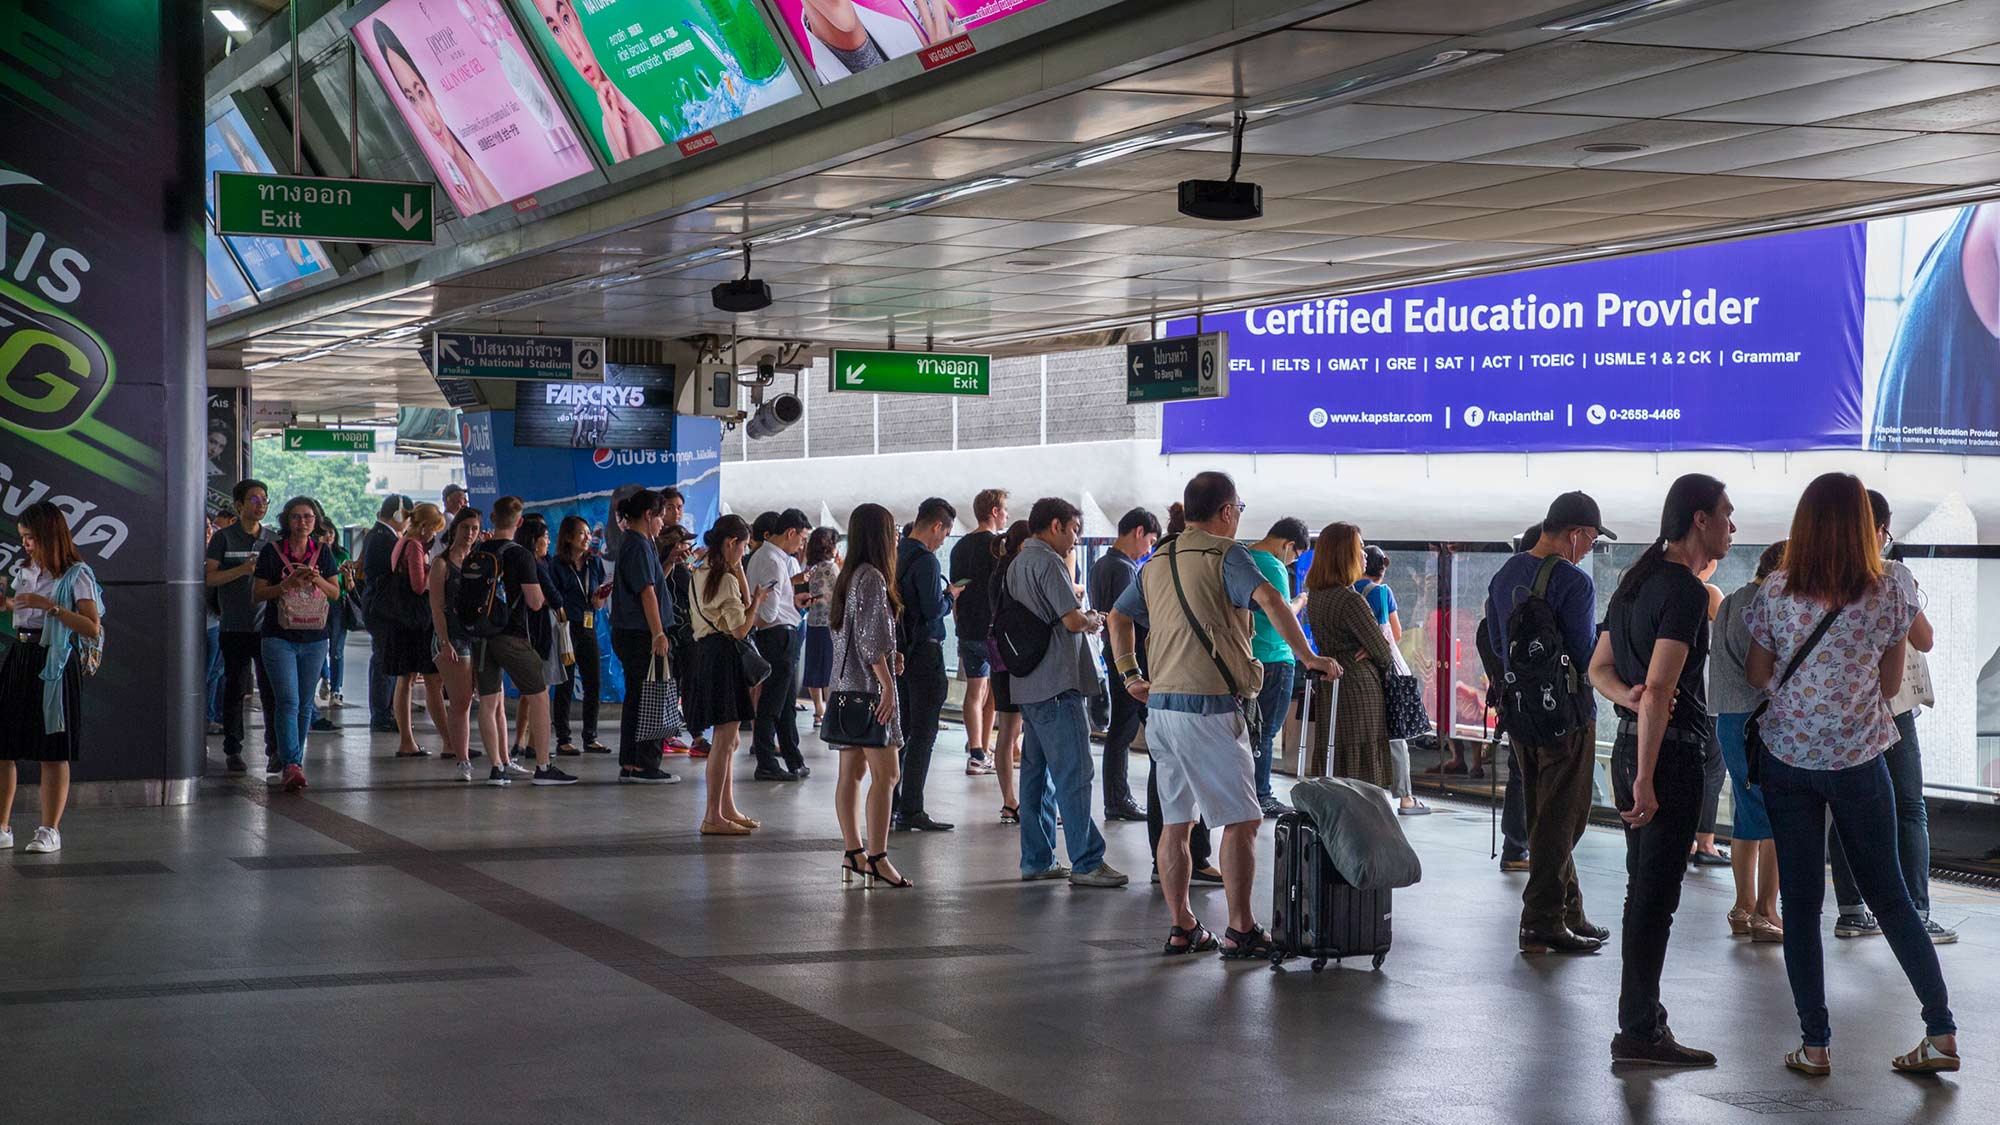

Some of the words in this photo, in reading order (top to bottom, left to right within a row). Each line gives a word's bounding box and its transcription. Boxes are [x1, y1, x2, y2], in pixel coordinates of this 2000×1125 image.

[937, 46, 957, 60] GLOBAL
[956, 39, 973, 54] MEDIA
[258, 184, 351, 206] ทางออก
[261, 210, 302, 229] Exit
[1245, 298, 1392, 335] Certified
[1404, 294, 1583, 333] Education
[1597, 288, 1760, 328] Provider
[470, 336, 562, 357] ไปสนามกีฬาฯ
[463, 357, 475, 367] To
[480, 357, 524, 368] National
[529, 360, 571, 369] Stadium
[917, 358, 979, 376] ทางออก
[1228, 358, 1255, 372] EFL
[1272, 358, 1311, 372] IELTS
[1327, 357, 1369, 372] GMAT
[1386, 357, 1417, 371] GRE
[1434, 356, 1464, 371] SAT
[1481, 355, 1513, 370] ACT
[1530, 353, 1575, 369] TOEIC
[1594, 352, 1646, 367] USMLE
[1649, 351, 1657, 366] 1
[1661, 351, 1674, 366] &
[1676, 351, 1686, 366] 2
[1688, 350, 1712, 365] CK
[1731, 349, 1802, 364] Grammar
[1154, 370, 1161, 379] To
[1161, 369, 1174, 380] Bang
[953, 377, 978, 389] Exit
[212, 400, 229, 409] AIS
[1330, 409, 1433, 424] www.kapstar.com
[1487, 408, 1554, 424] /kaplanthai
[1609, 408, 1681, 421] 0-2658-4466
[332, 431, 369, 442] ทางออก
[1875, 426, 1900, 435] Kaplan
[1902, 426, 1932, 435] Certified
[1933, 427, 1968, 436] Education
[1969, 428, 1999, 438] Provider
[1937, 436, 1967, 445] registered
